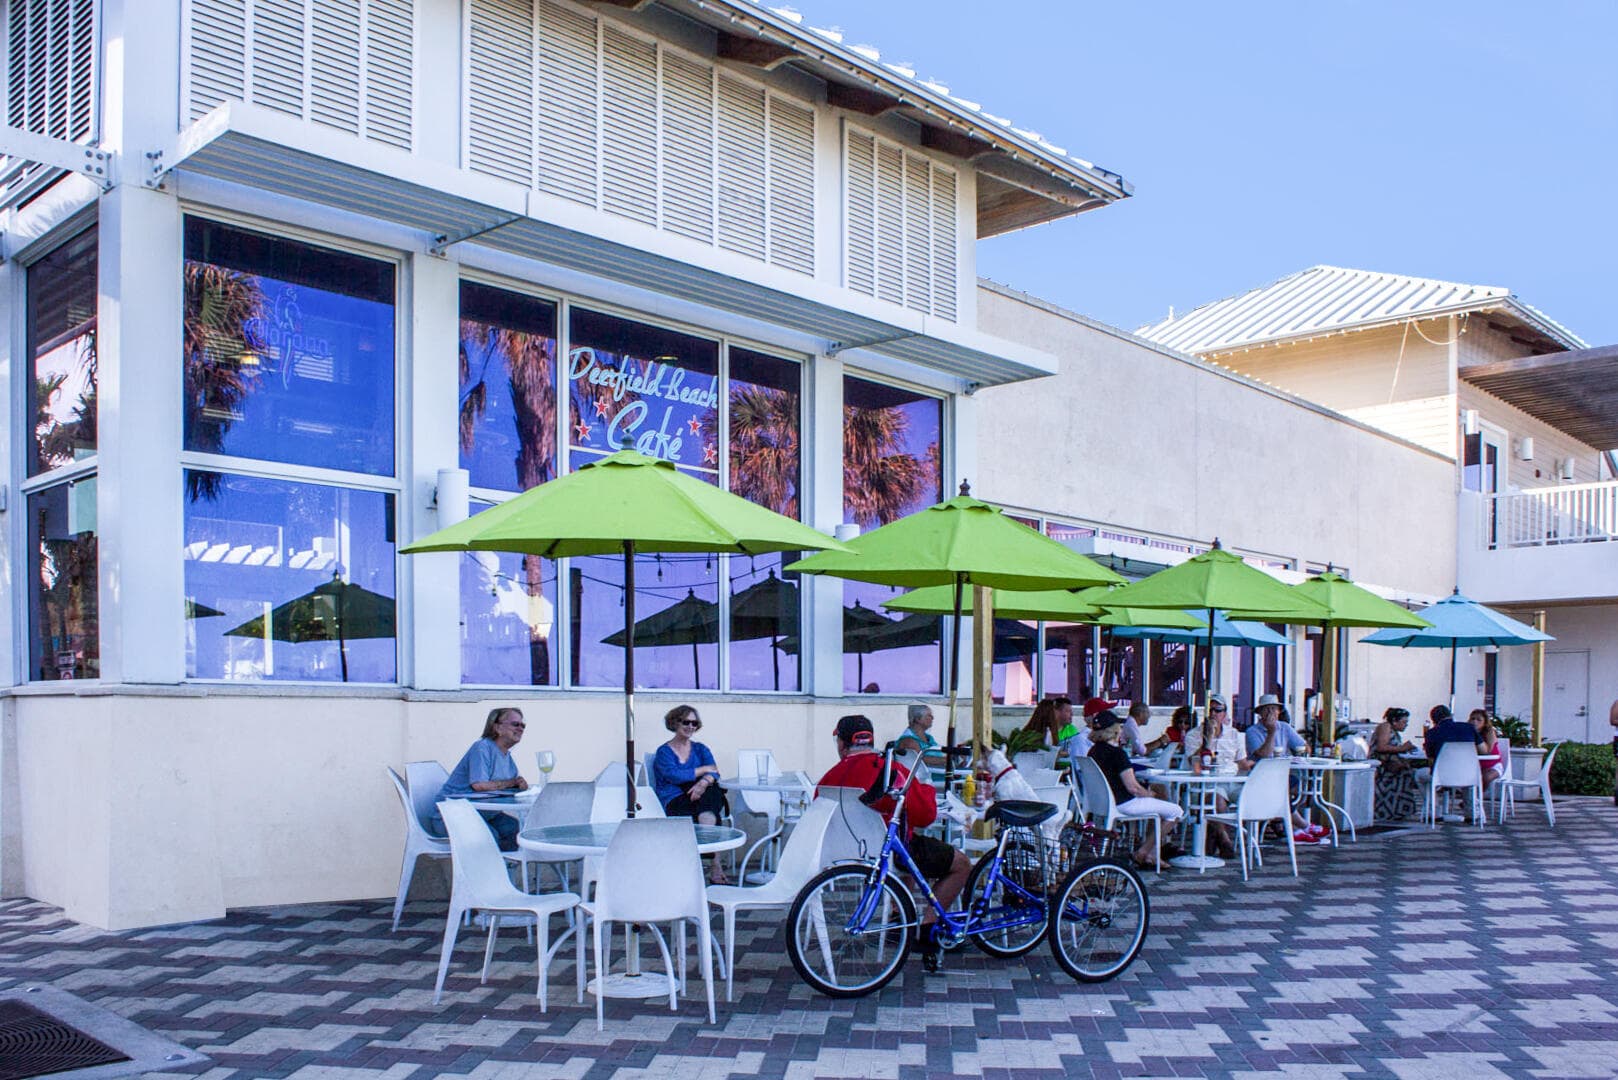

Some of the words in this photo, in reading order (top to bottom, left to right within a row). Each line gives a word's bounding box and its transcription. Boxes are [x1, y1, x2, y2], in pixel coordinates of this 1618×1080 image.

[569, 346, 662, 402] Deerfield
[661, 367, 718, 409] Beach
[607, 400, 683, 461] Café
